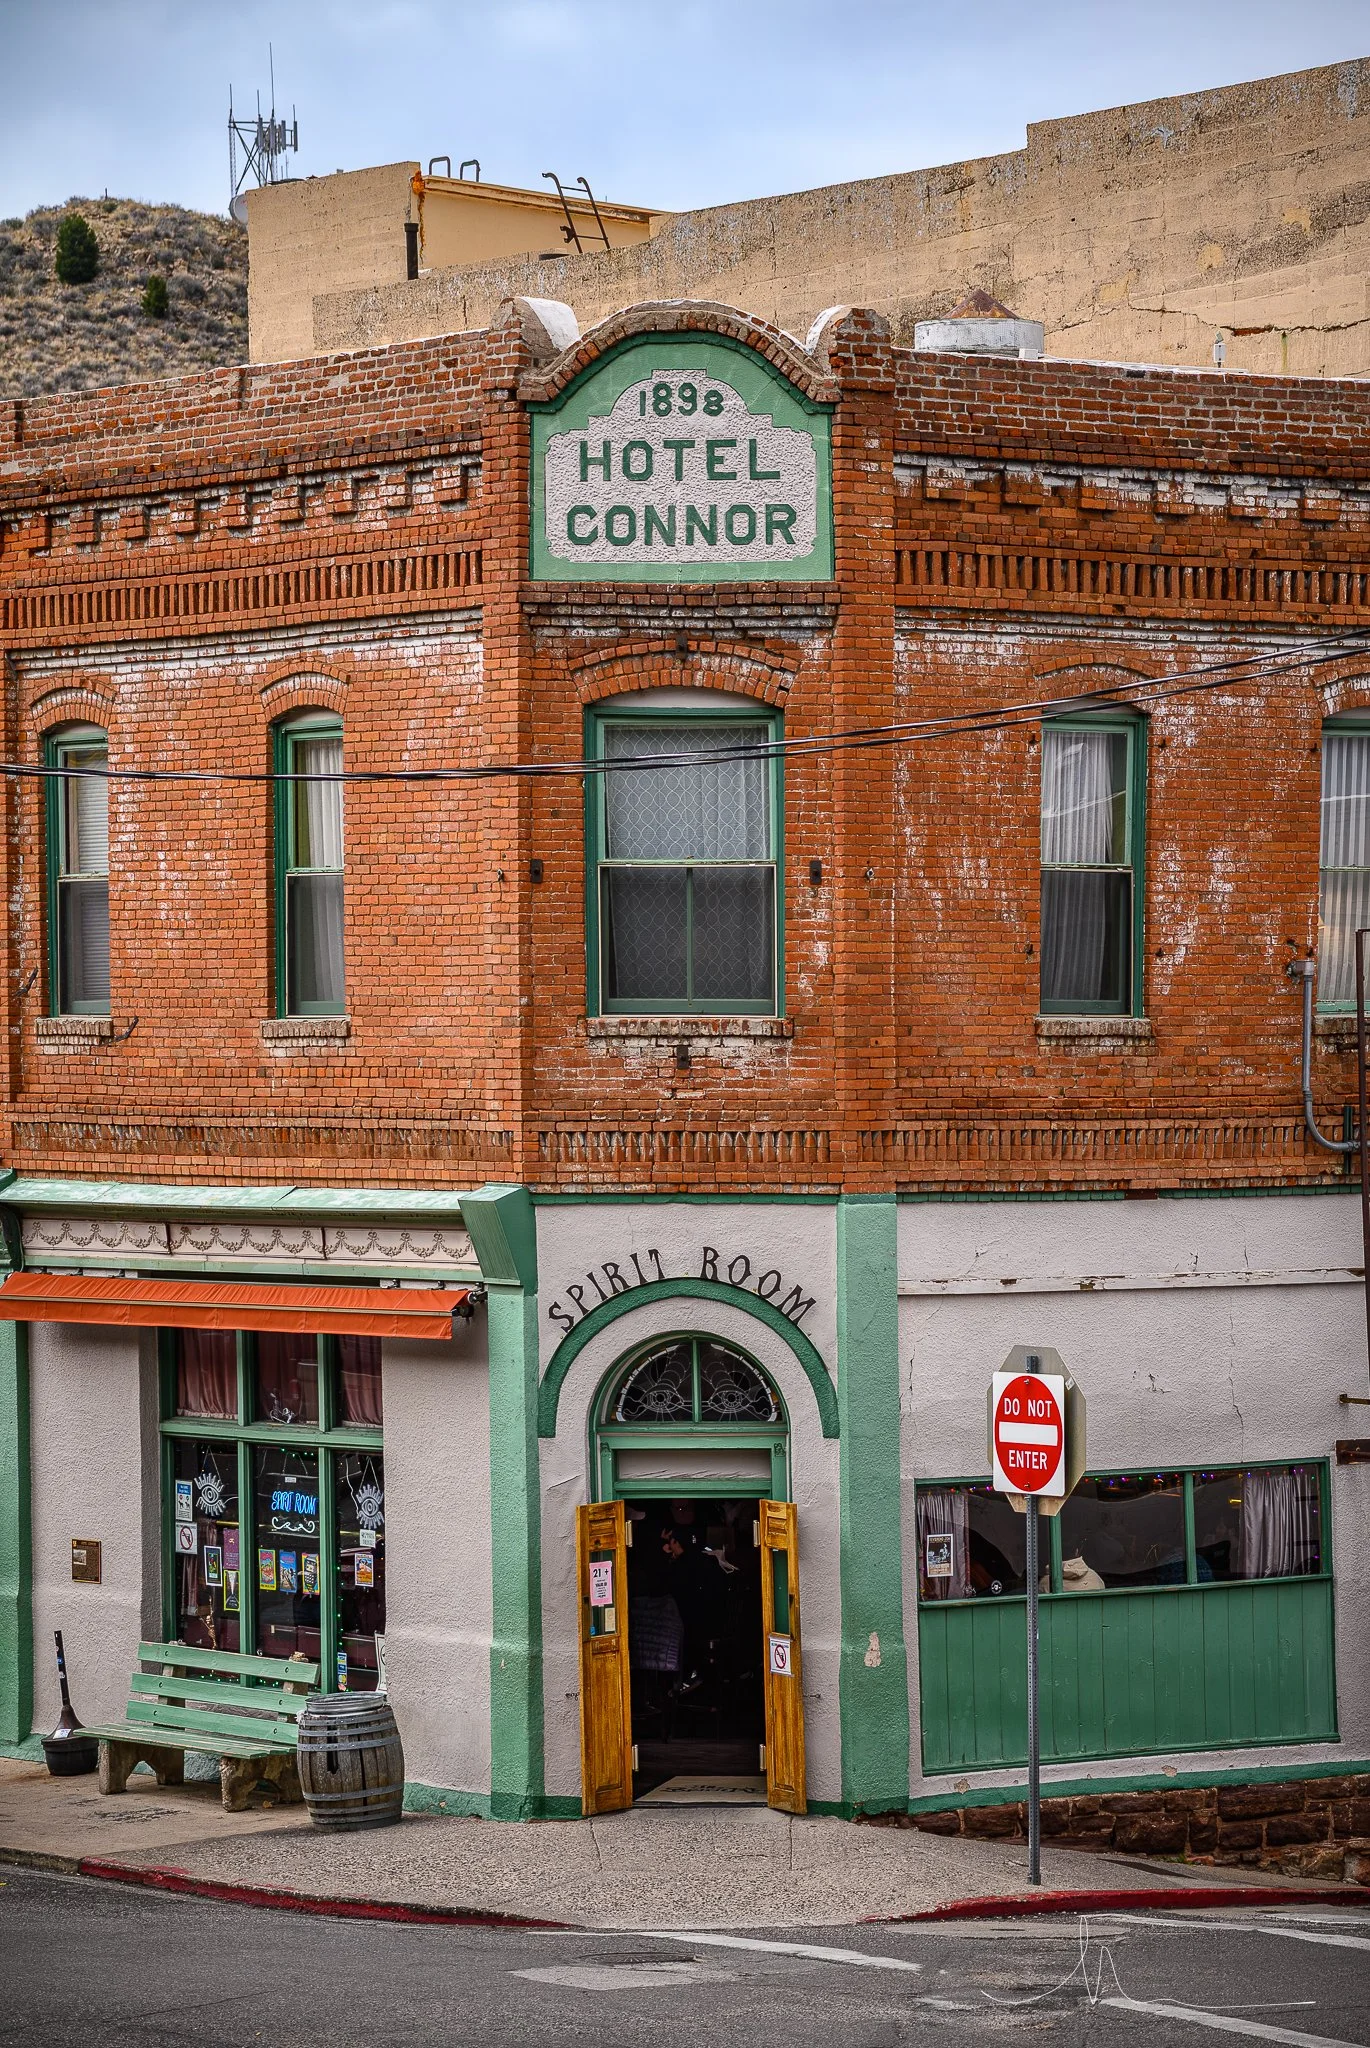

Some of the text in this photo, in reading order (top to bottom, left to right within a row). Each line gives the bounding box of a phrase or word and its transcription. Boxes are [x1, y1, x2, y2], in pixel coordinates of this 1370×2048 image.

[639, 381, 725, 417] 1898
[579, 438, 781, 482] HOTEL
[566, 503, 798, 547] CONNOR
[548, 1246, 817, 1333] SPIRIT ROOM
[1004, 1398, 1052, 1418] DO NOT
[1008, 1449, 1048, 1470] ENTER
[294, 1492, 316, 1515] ROOM
